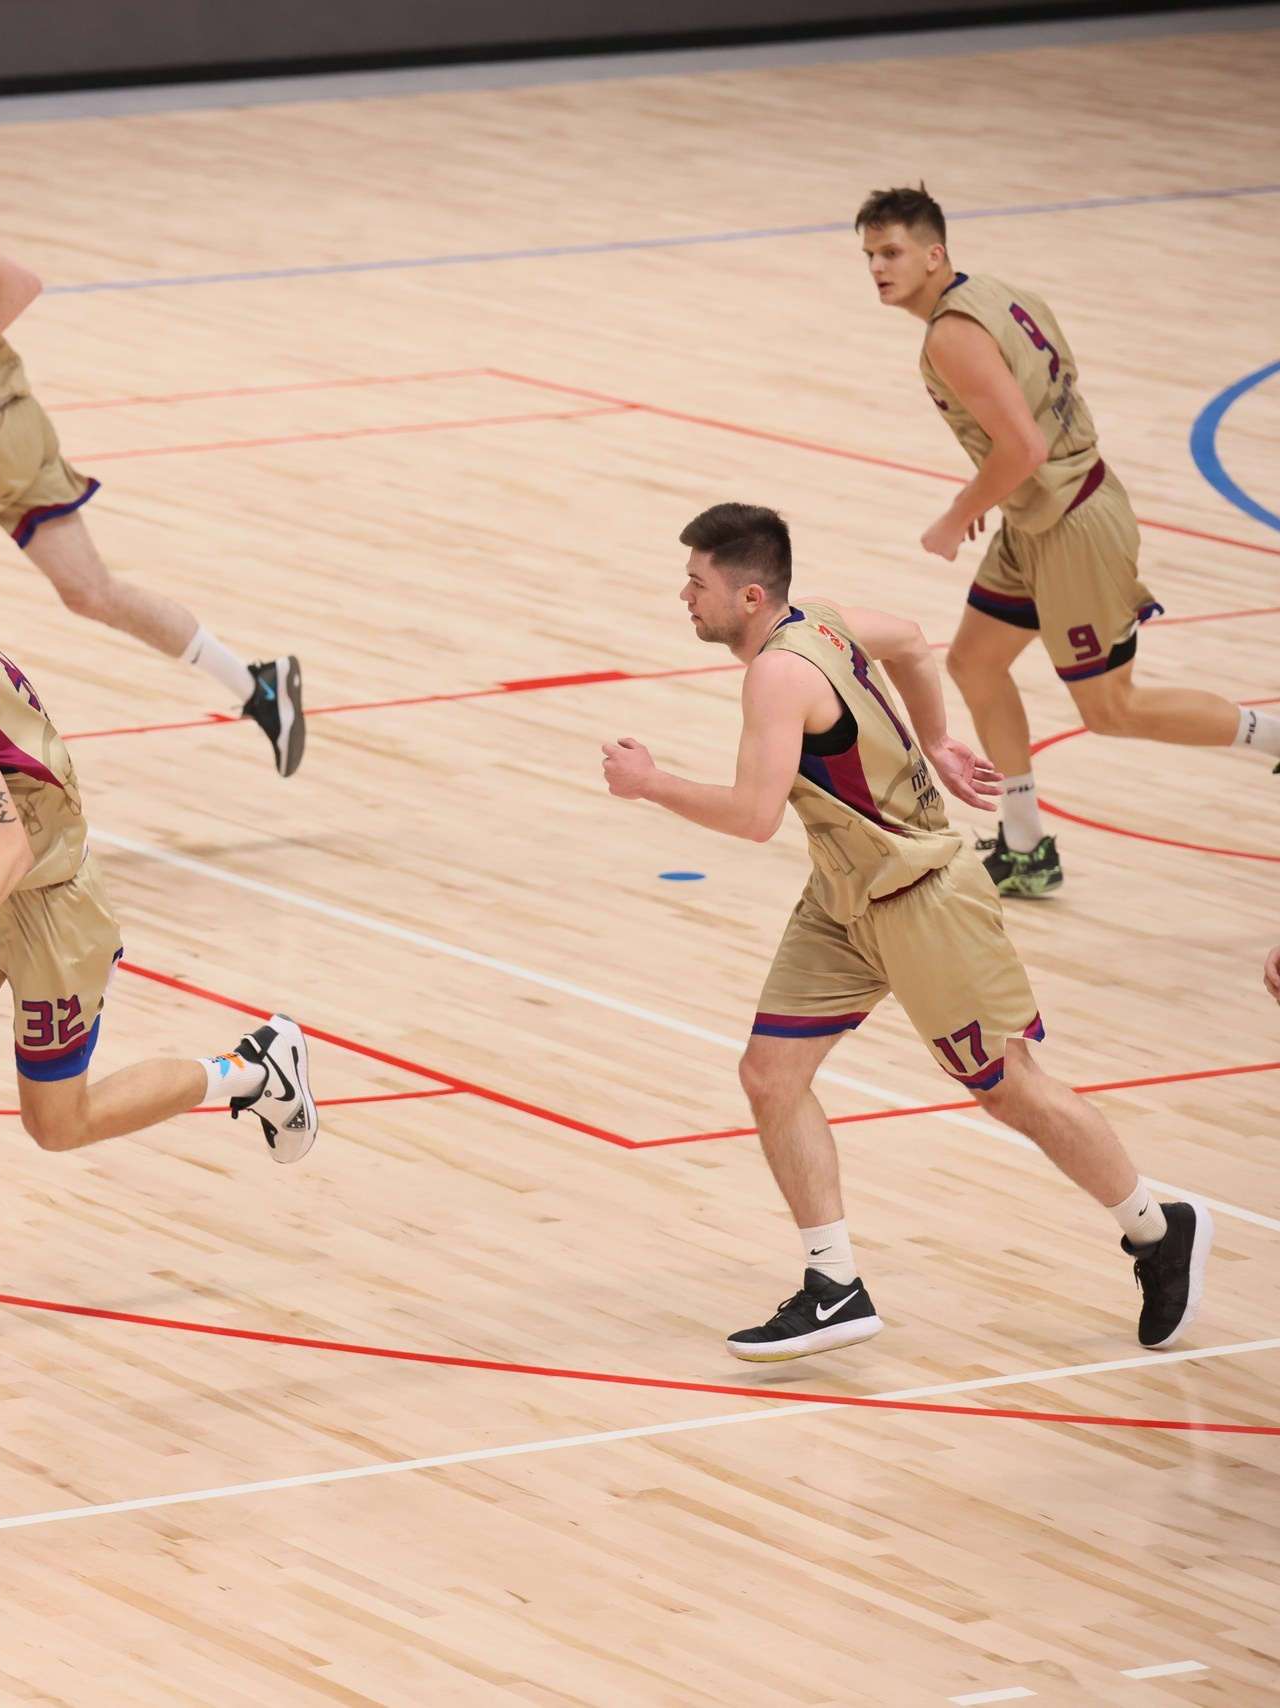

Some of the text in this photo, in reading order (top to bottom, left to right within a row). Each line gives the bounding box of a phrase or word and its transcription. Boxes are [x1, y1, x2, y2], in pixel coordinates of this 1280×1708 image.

[1067, 622, 1102, 661] 9
[22, 994, 85, 1046] 32
[931, 1019, 989, 1073] 17
